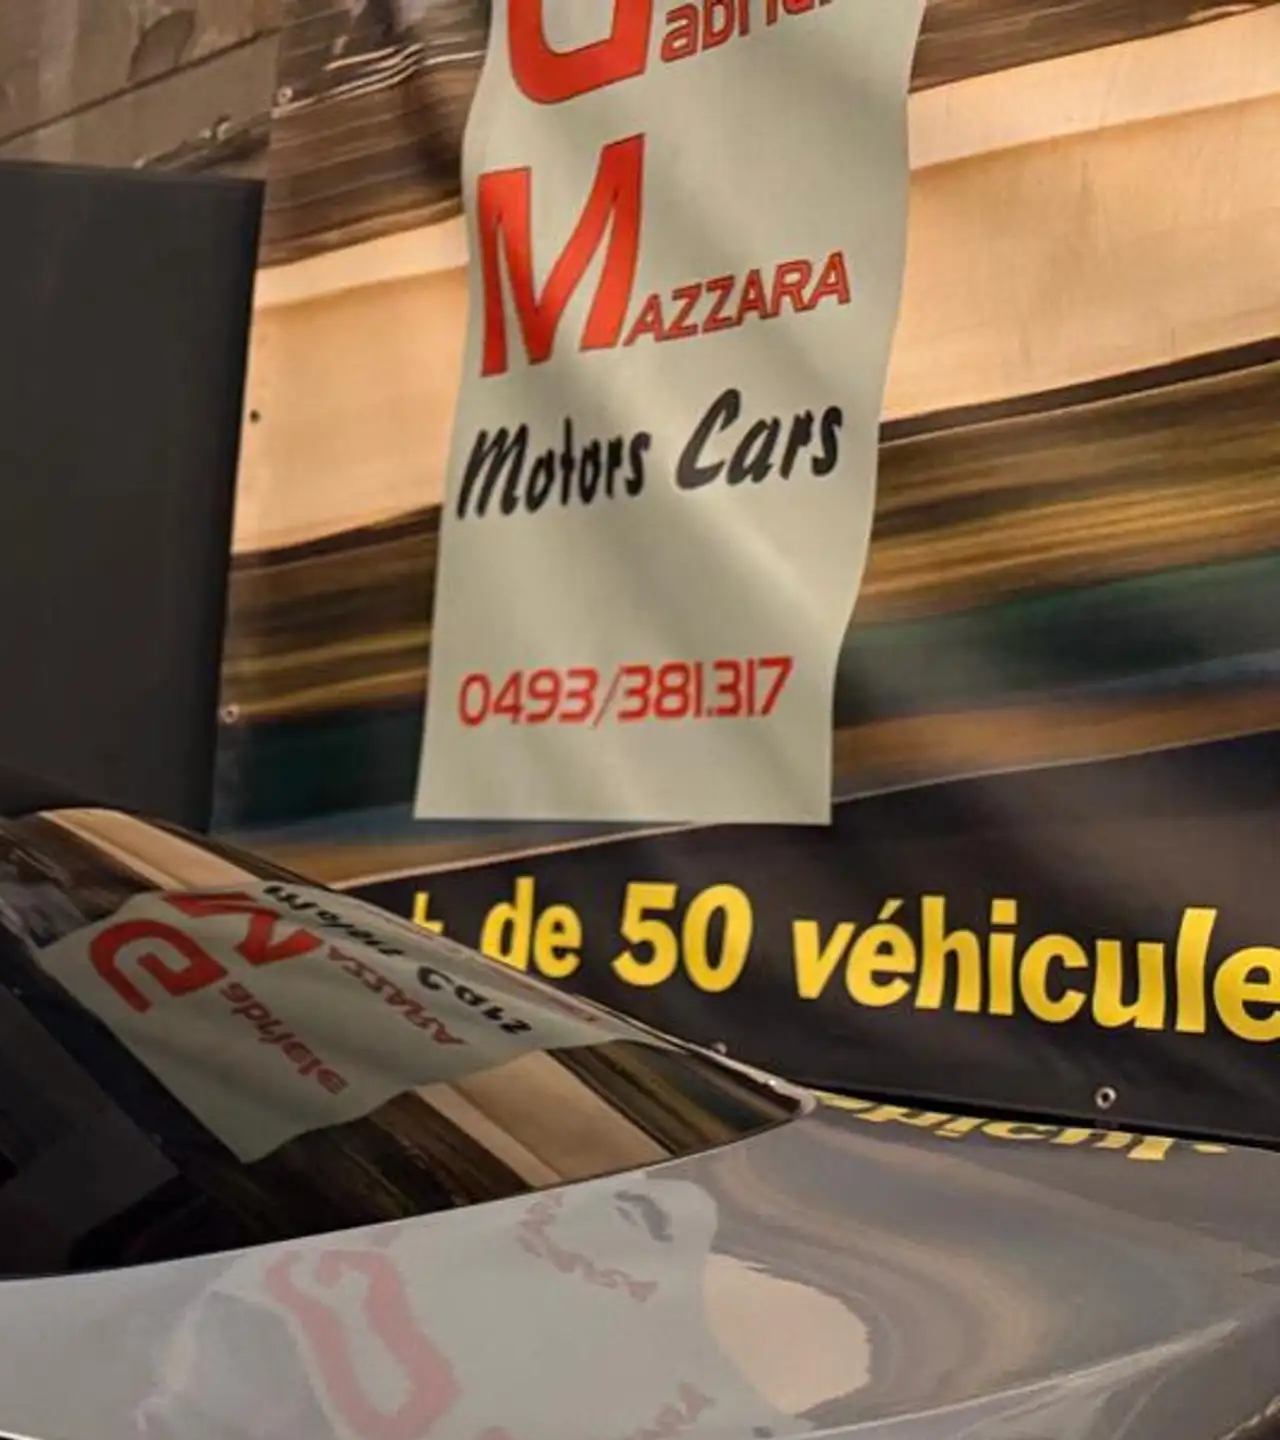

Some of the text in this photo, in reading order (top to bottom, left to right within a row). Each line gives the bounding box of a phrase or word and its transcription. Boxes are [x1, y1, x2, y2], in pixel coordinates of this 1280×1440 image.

[478, 132, 852, 378] MAZZARA
[456, 388, 844, 520] Motors Cars
[479, 876, 583, 978] de
[611, 882, 753, 993] 50
